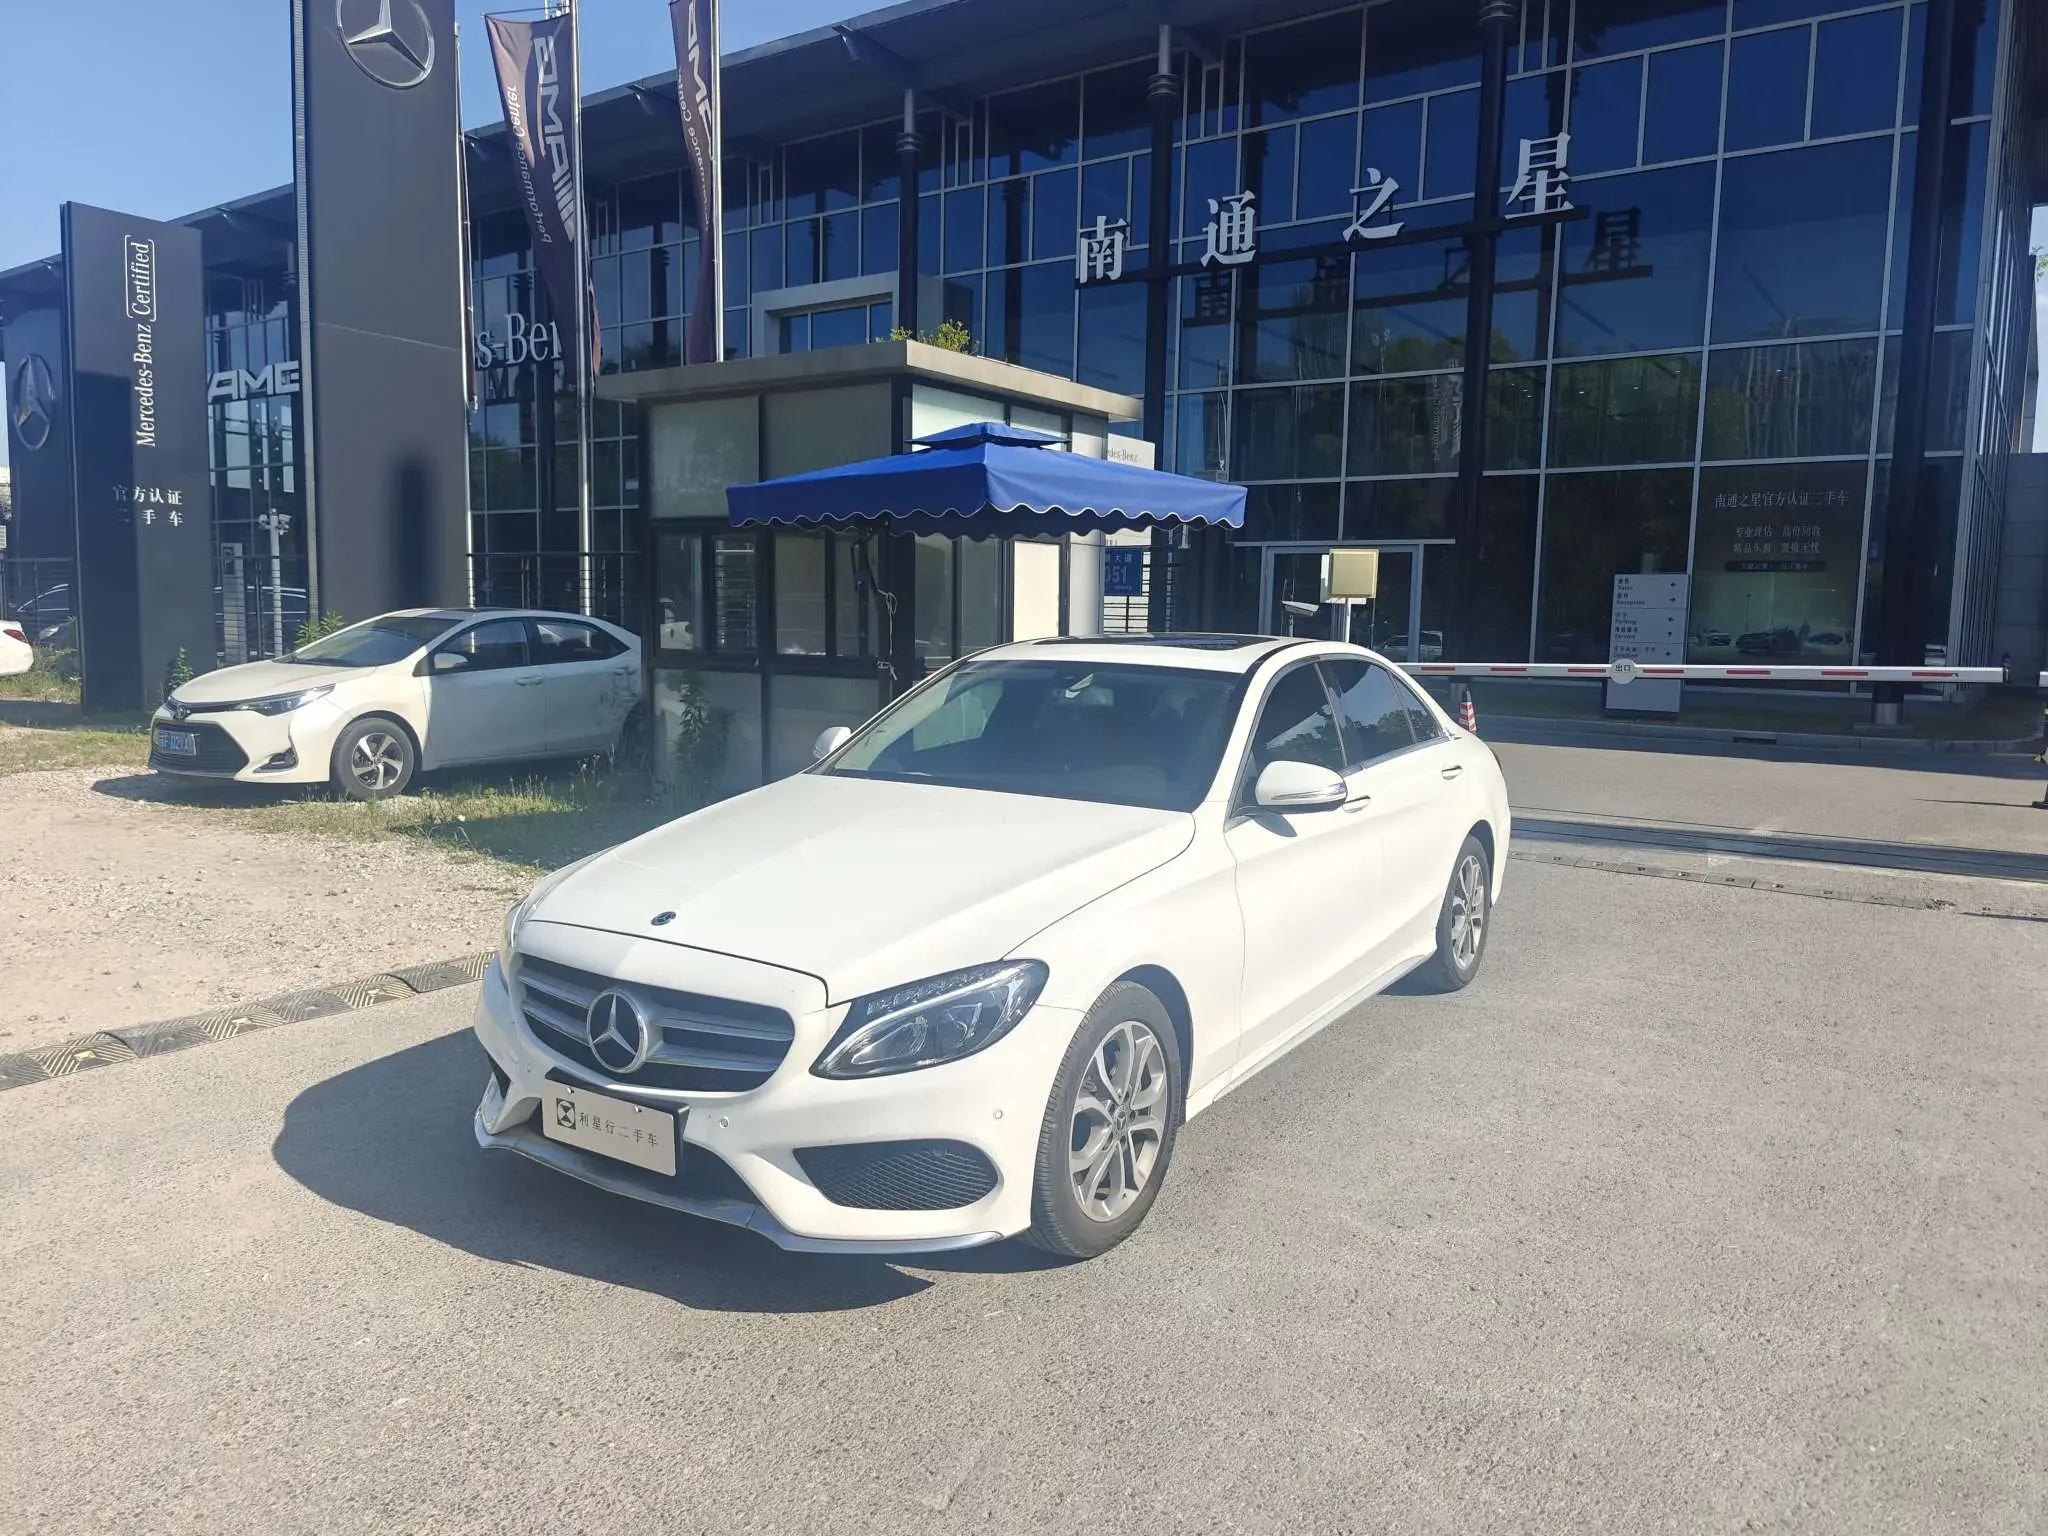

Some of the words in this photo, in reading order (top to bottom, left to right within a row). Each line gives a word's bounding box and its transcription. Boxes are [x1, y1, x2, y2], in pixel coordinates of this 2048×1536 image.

[1079, 132, 1575, 284] 南通之星
[130, 242, 151, 316] Certified
[133, 323, 156, 448] Mercedes-Benz
[113, 484, 184, 506] 官方认证
[1715, 490, 1850, 508] 南通之星官方认证二手车
[114, 508, 184, 527] 二手车
[1615, 665, 1632, 673] 出口
[579, 1112, 658, 1148] 利星行二手车
